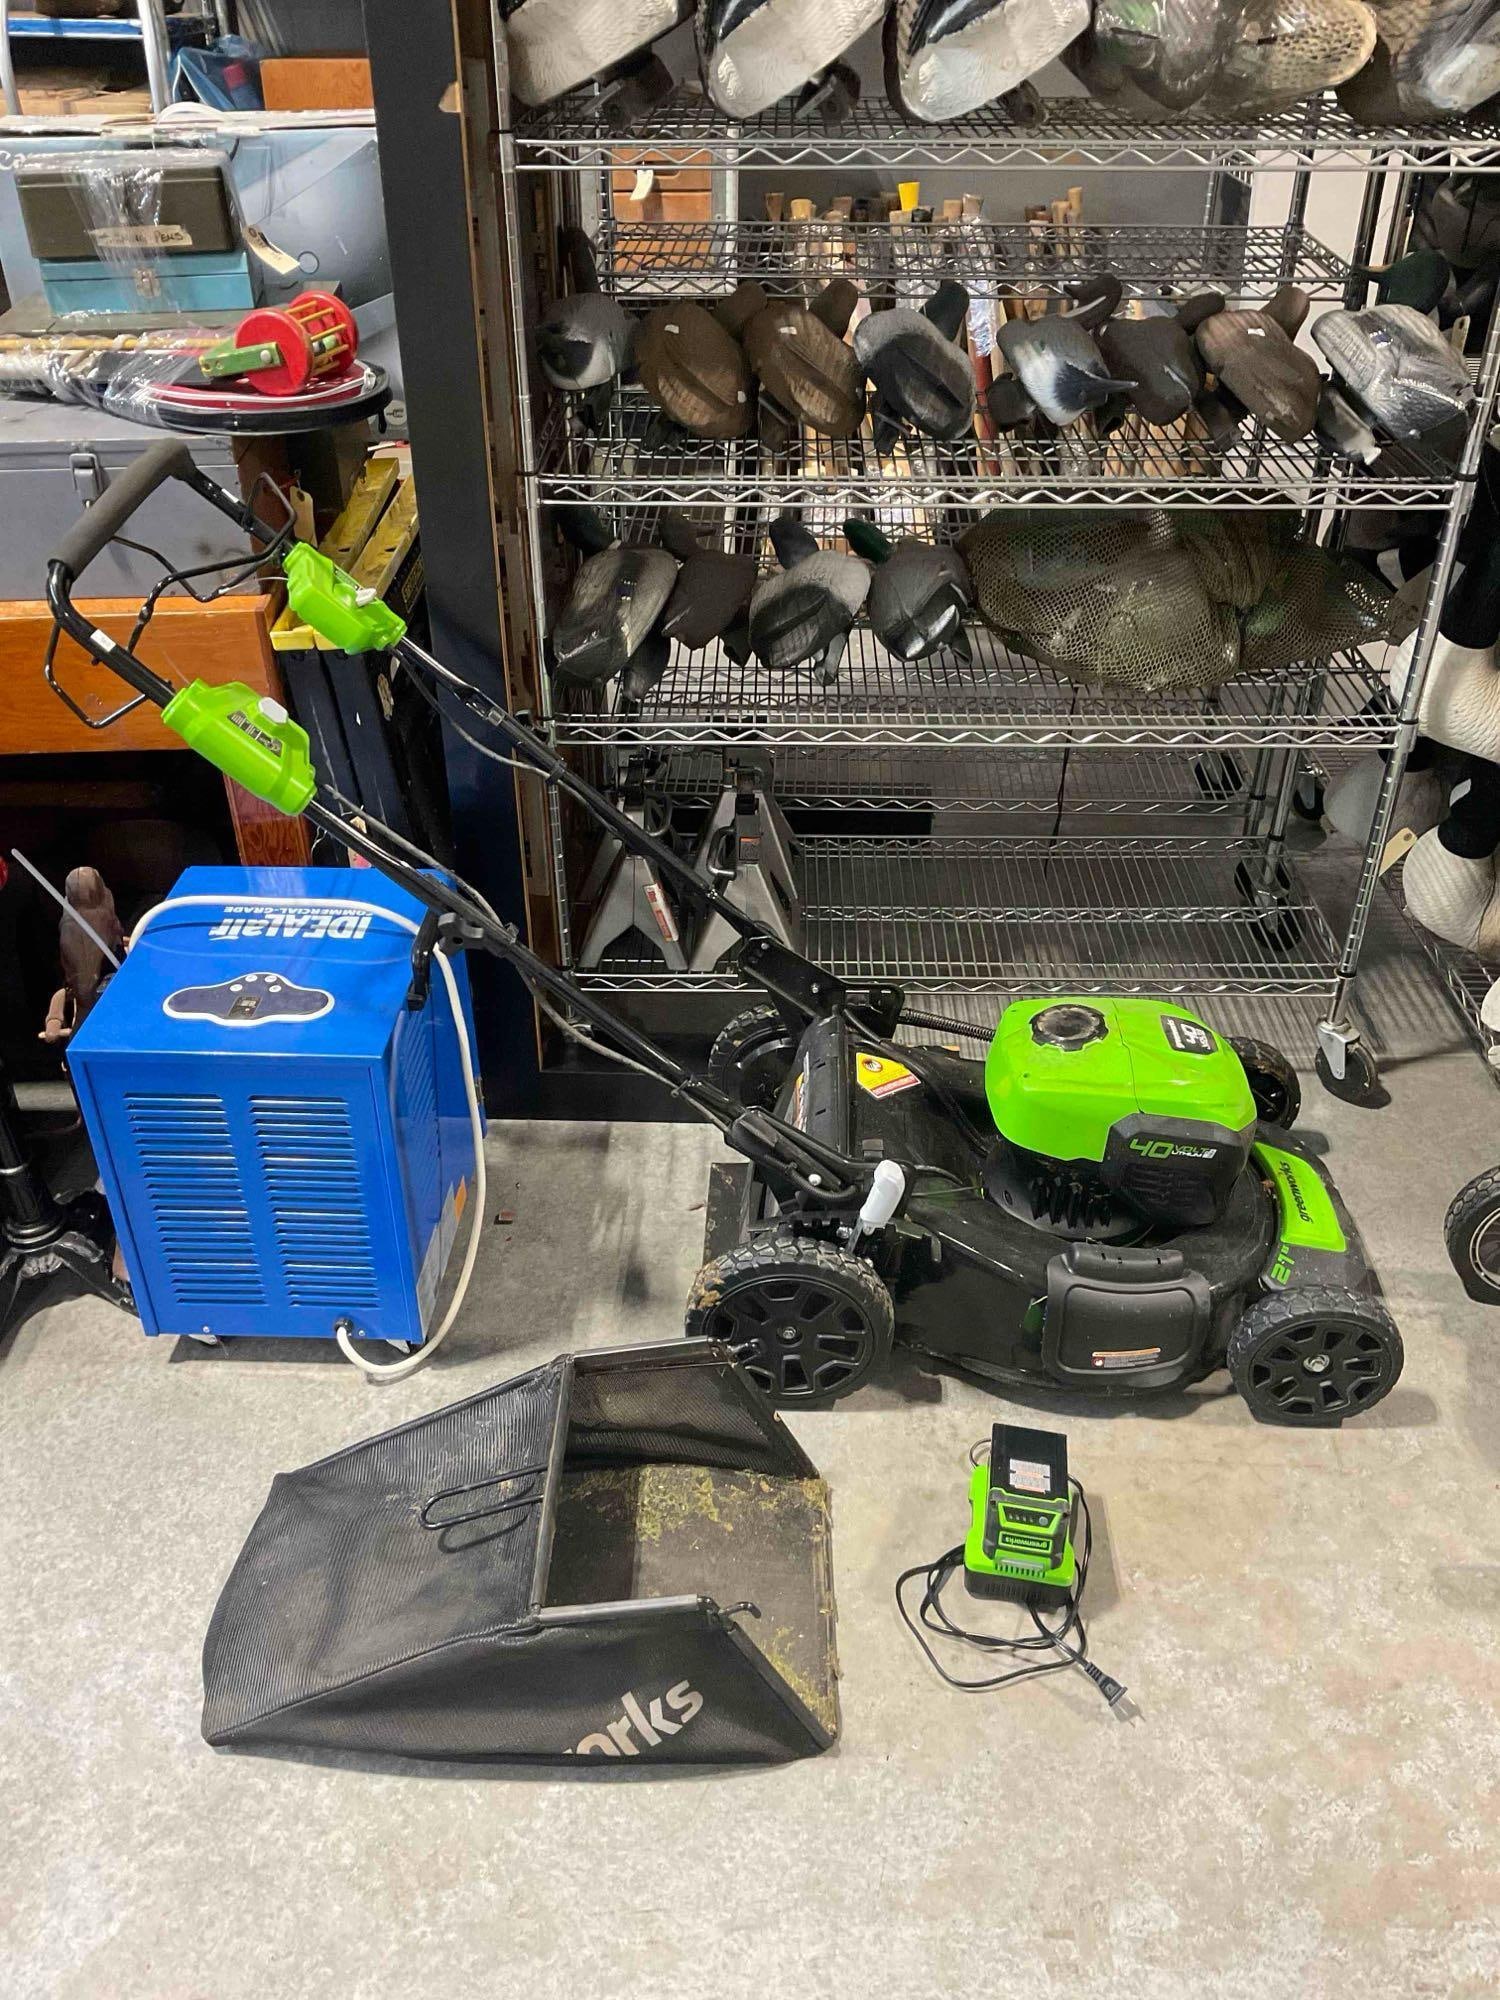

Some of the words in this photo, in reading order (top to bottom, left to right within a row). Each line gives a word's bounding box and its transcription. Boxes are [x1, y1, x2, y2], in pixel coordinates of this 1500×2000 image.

[1129, 1139, 1175, 1159] 40
[1174, 1144, 1209, 1153] VOLT
[1280, 1161, 1313, 1223] greenworks
[562, 1680, 704, 1756] orks
